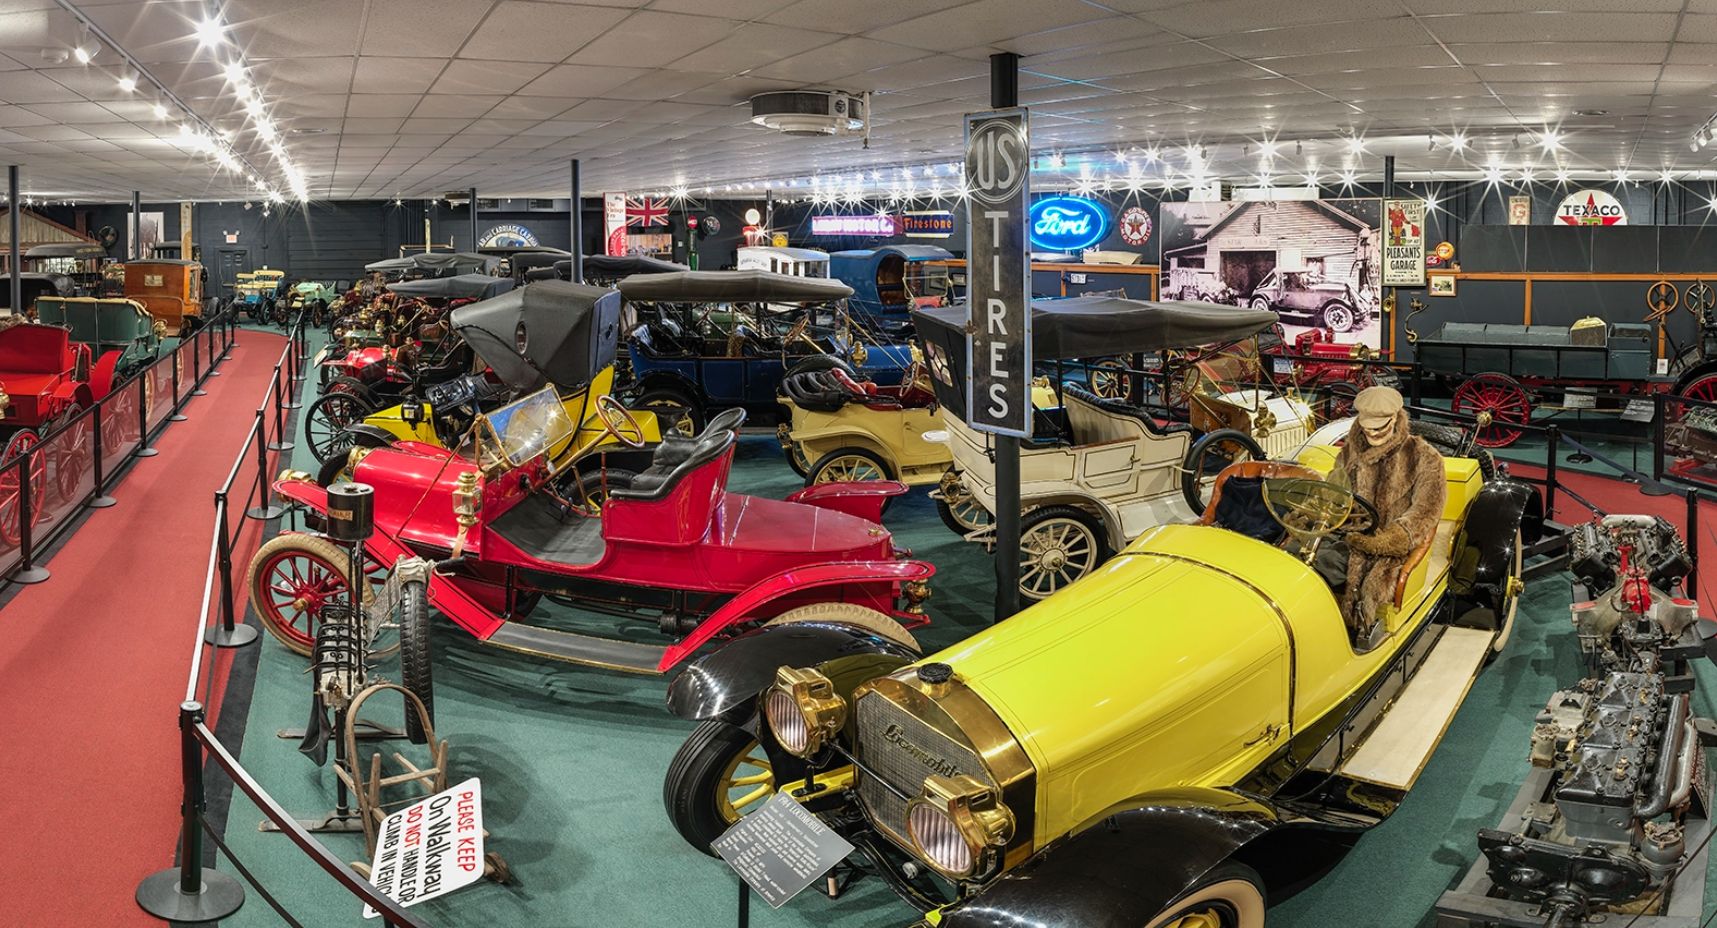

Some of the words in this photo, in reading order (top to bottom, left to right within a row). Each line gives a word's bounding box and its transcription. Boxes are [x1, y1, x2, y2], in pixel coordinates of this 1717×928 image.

[976, 131, 1016, 190] US
[904, 217, 952, 229] Firestone
[1035, 206, 1092, 235] Ford
[1563, 205, 1620, 216] TEXACO
[1386, 247, 1421, 259] PLEASANTS
[1390, 260, 1417, 270] GARAGE
[984, 211, 1009, 419] TIRES
[406, 805, 424, 824] DO
[428, 796, 452, 820] On
[457, 791, 475, 833] PLEASE
[787, 804, 827, 836] LOCOMOBILE
[384, 814, 402, 849] CLIMB
[404, 823, 423, 848] NOT
[381, 849, 398, 863] IN
[399, 848, 420, 889] HANDLE
[417, 816, 452, 898] Walkway
[457, 838, 476, 872] KEEP
[398, 887, 416, 904] OR
